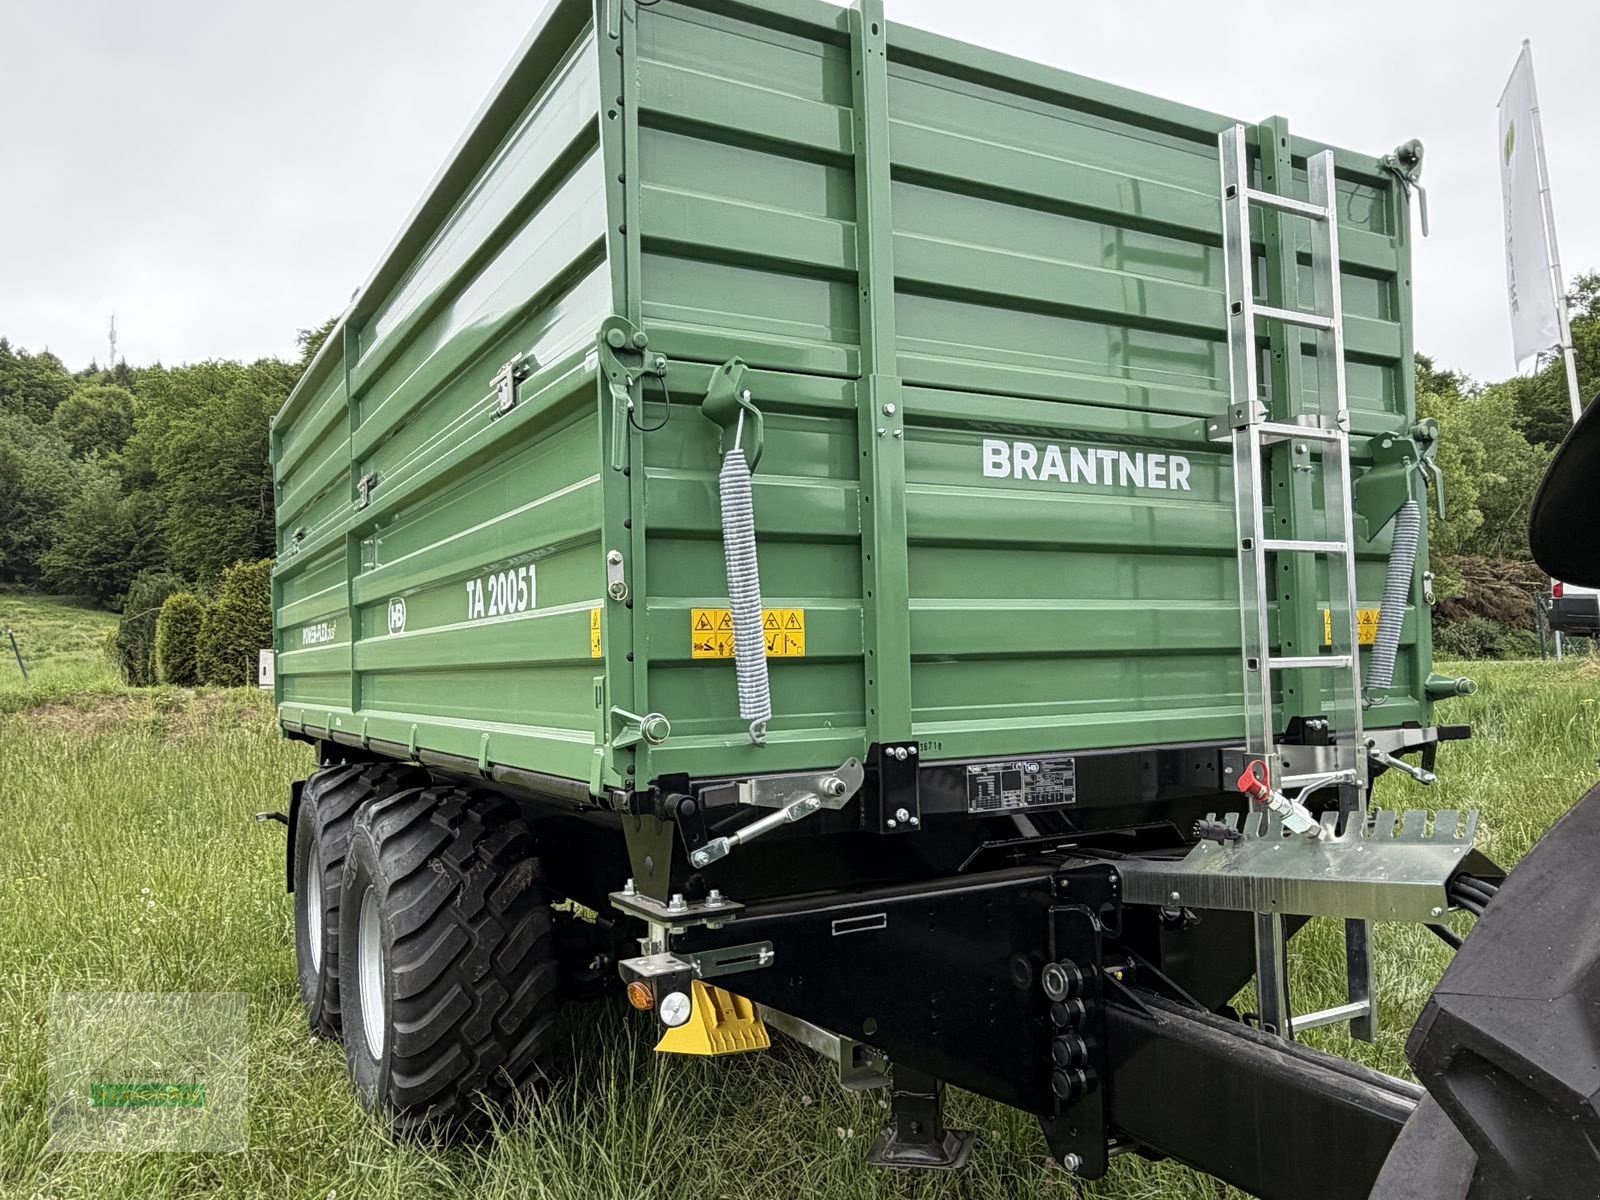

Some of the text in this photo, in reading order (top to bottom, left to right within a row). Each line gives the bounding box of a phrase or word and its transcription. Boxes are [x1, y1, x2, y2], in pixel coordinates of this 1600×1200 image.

[982, 438, 1192, 491] BRANTNER
[466, 564, 537, 619] TA 20051
